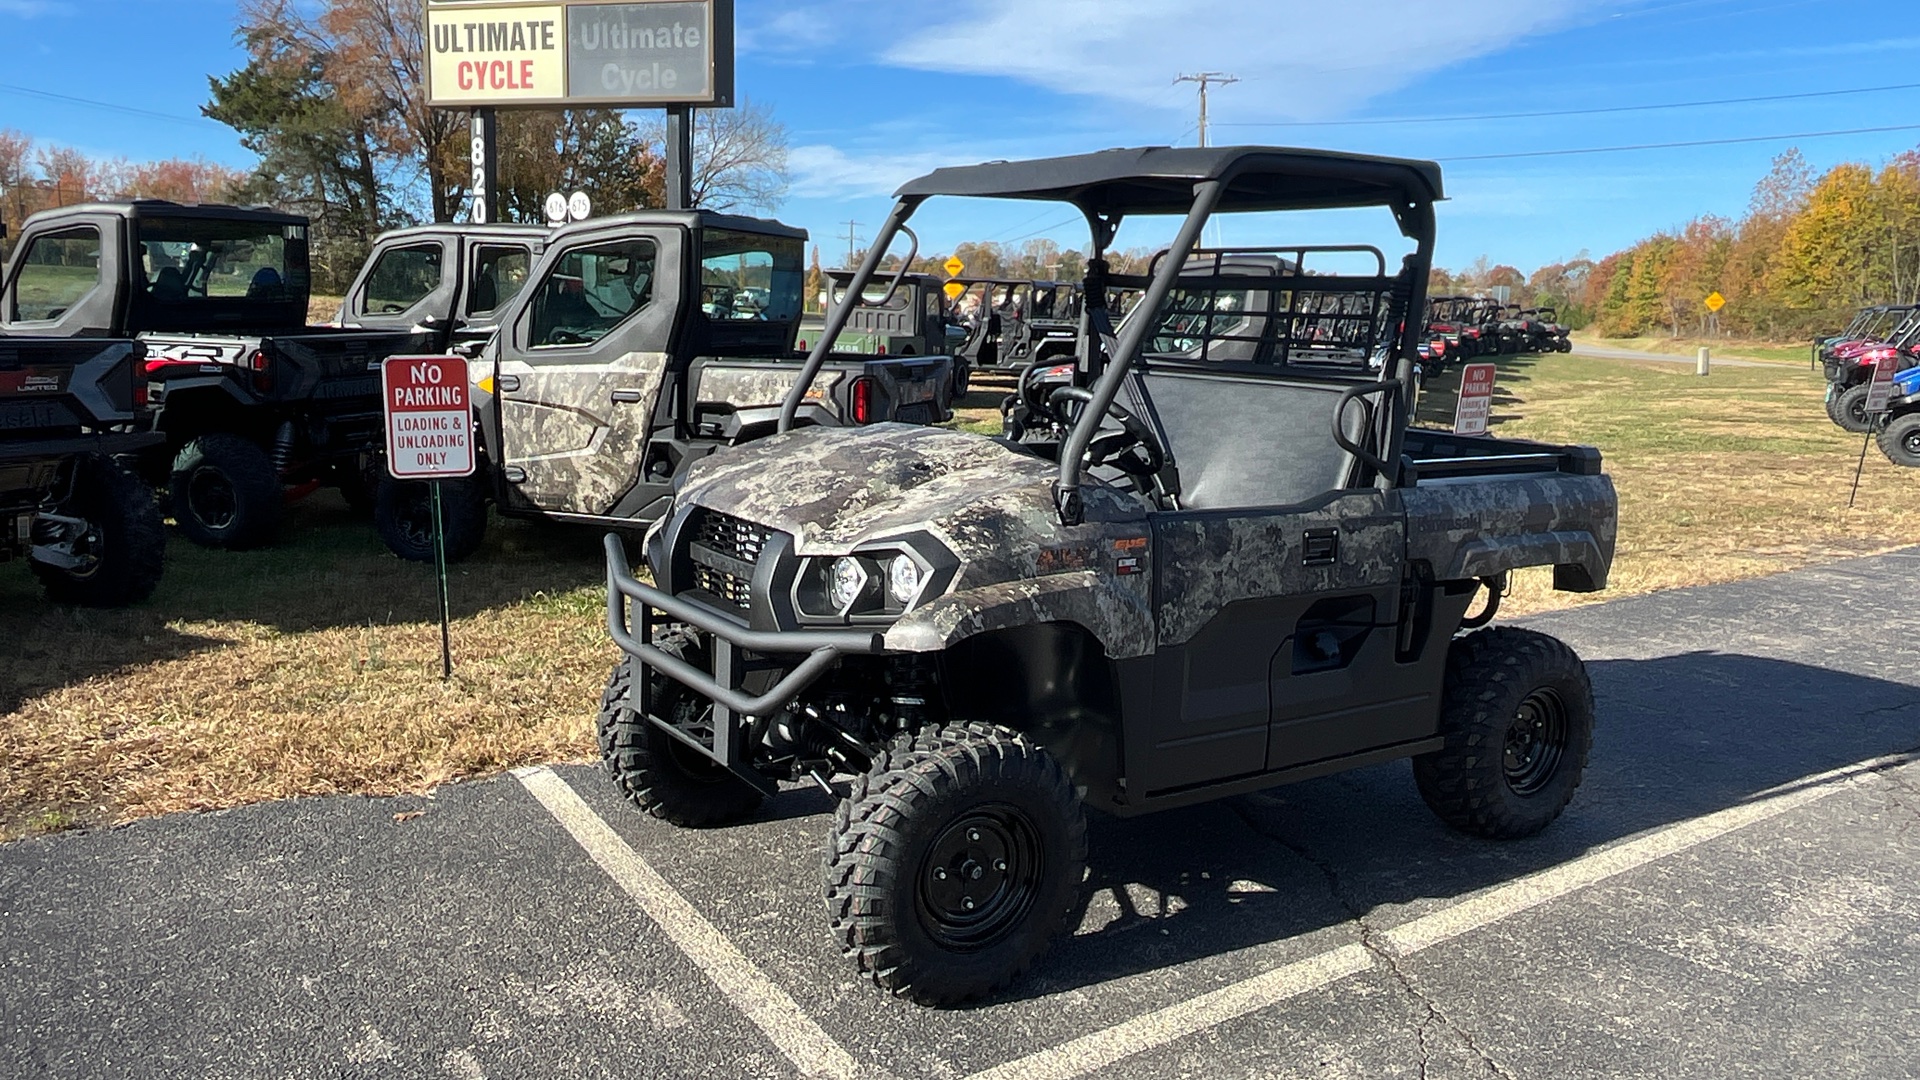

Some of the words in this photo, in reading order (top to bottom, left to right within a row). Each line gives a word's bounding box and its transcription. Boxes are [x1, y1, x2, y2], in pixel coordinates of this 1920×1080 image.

[434, 20, 554, 53] ULTIMATE
[581, 21, 700, 50] Ultimate
[457, 60, 534, 90] CYCLE
[601, 62, 677, 92] Cycle
[549, 201, 564, 213] 676
[572, 199, 587, 212] 675
[410, 365, 442, 385] NO
[1473, 370, 1486, 381] NO
[1464, 382, 1490, 394] PARKING
[394, 386, 462, 406] PARKING
[397, 417, 448, 431] LOADING
[452, 416, 462, 430] &
[397, 434, 464, 449] UNLOADING
[417, 452, 447, 465] ONLY
